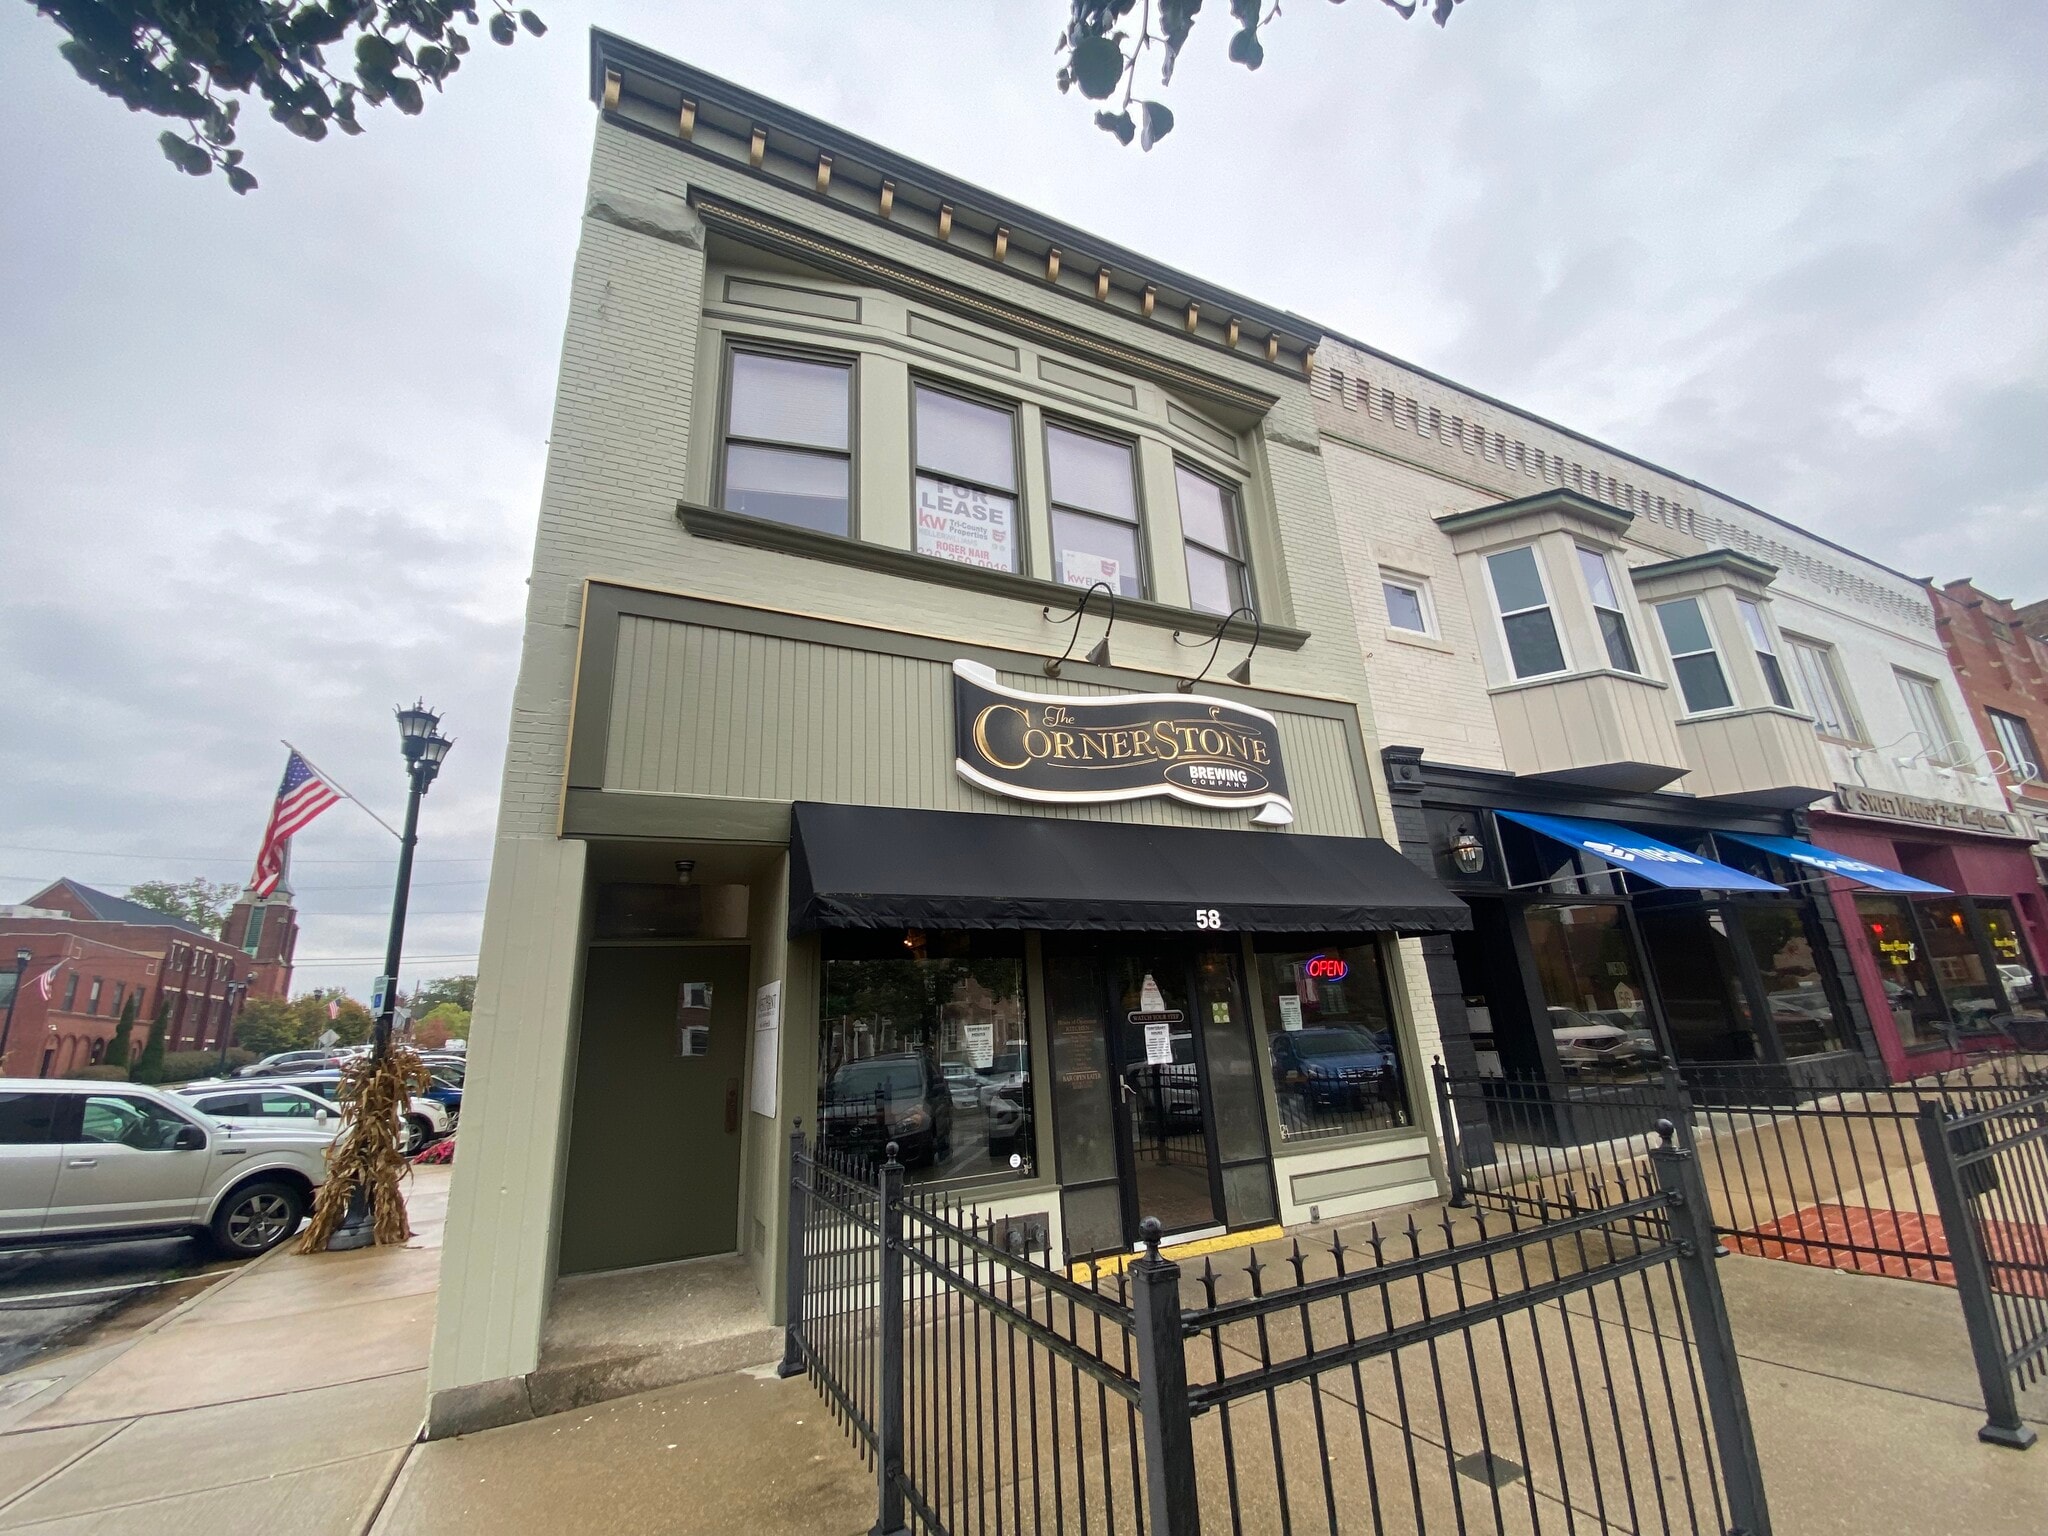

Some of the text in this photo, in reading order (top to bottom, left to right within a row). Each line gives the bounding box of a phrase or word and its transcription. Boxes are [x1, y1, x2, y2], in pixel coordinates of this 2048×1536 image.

[937, 482, 988, 505] FOR
[921, 491, 1004, 526] LEASE
[949, 526, 988, 540] Properties
[950, 519, 988, 535] Tri-County
[936, 540, 966, 555] ROGER
[1042, 705, 1075, 728] The
[972, 703, 1271, 770] CORNERSTONE
[1189, 765, 1248, 783] BREWING
[1191, 778, 1247, 789] COMPANY
[1857, 791, 1896, 815] SWEET
[1196, 909, 1221, 929] 58
[1309, 960, 1344, 977] OPEN
